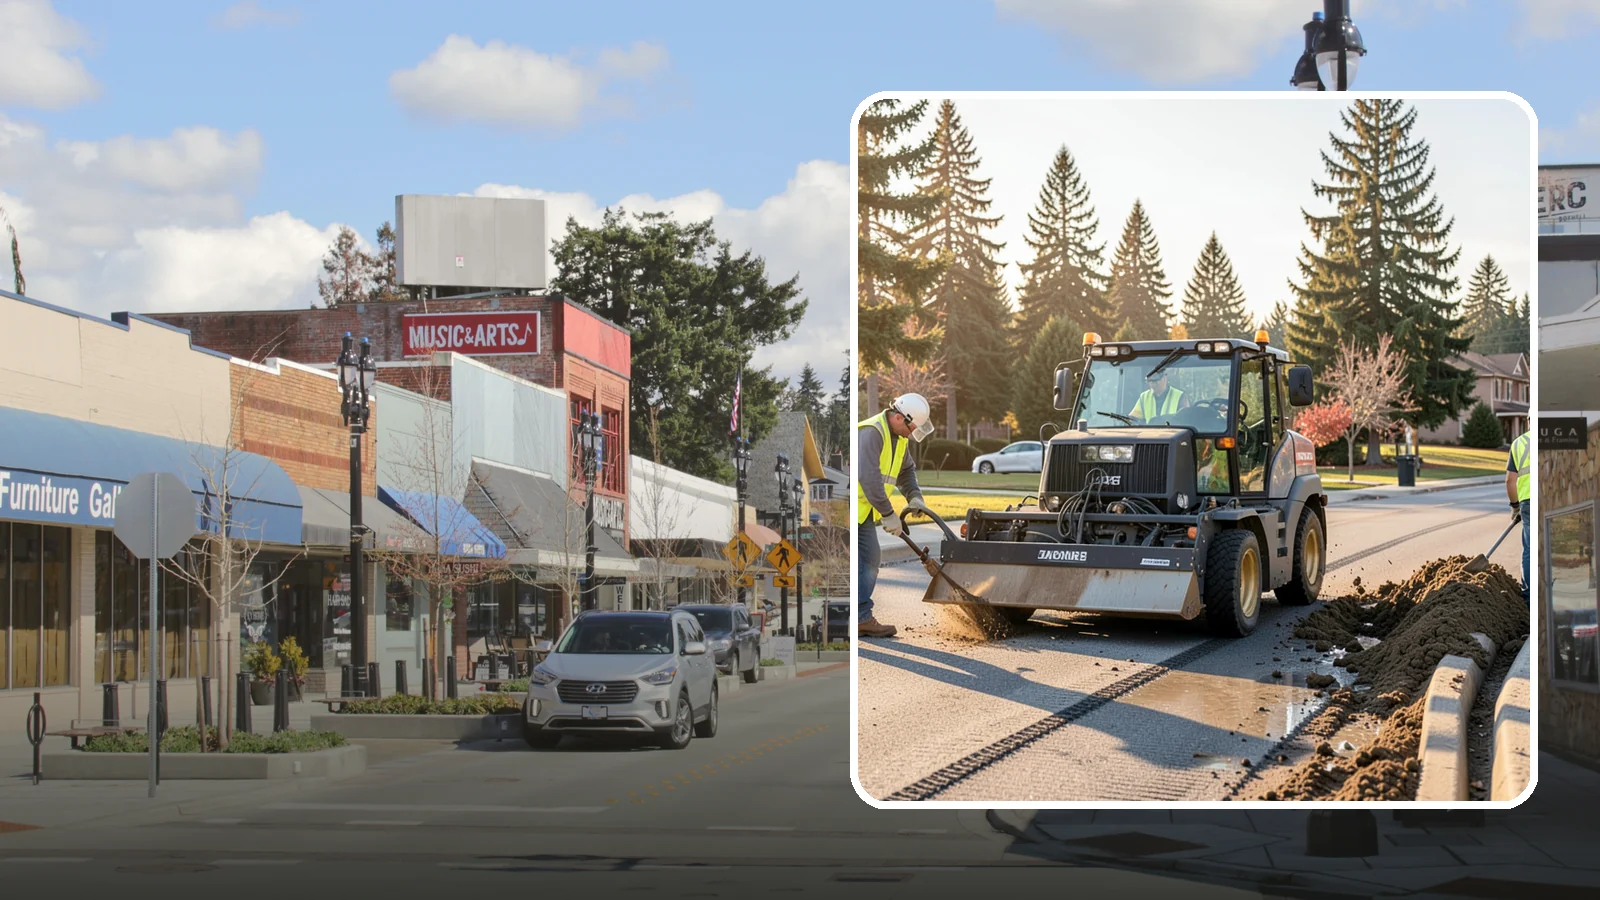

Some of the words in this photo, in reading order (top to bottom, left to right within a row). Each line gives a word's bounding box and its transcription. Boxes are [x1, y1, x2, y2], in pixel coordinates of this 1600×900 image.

[408, 323, 520, 349] MUSIC&ARTS
[1540, 427, 1578, 437] UGA
[0, 471, 79, 515] Furniture
[89, 482, 122, 519] Gal
[453, 563, 479, 574] SUSHI
